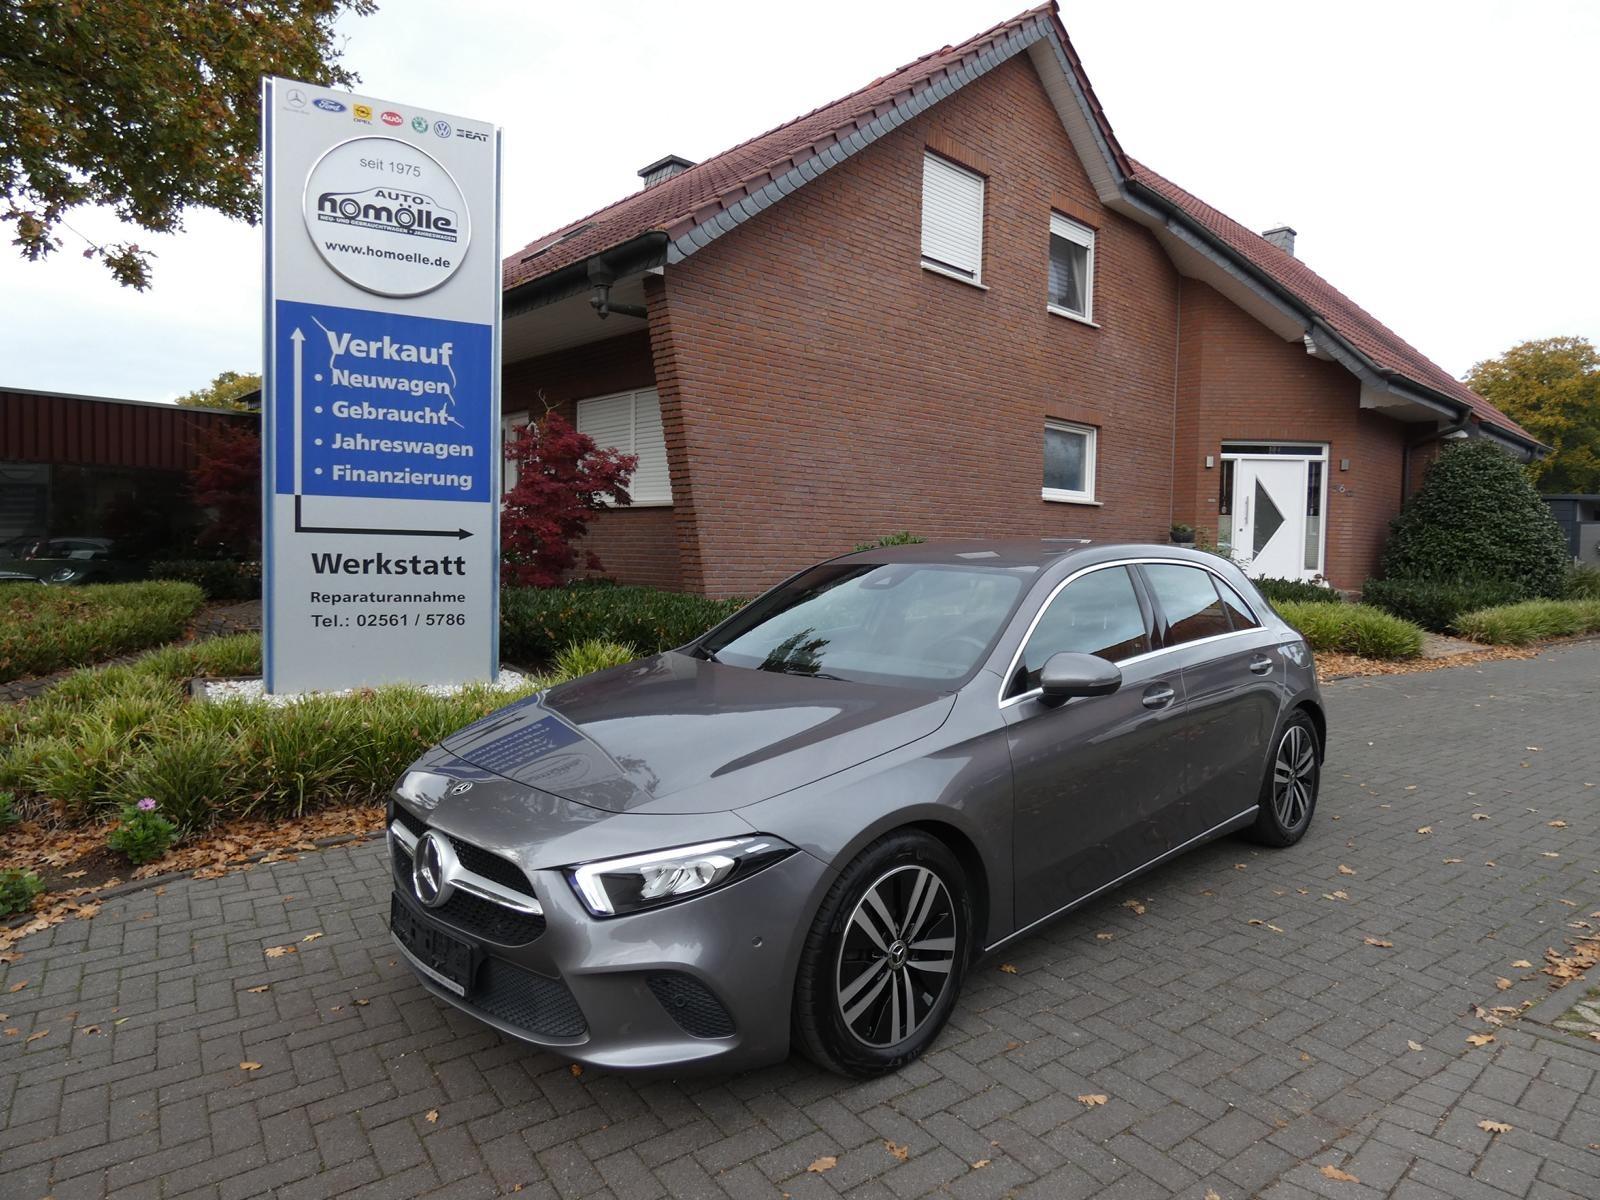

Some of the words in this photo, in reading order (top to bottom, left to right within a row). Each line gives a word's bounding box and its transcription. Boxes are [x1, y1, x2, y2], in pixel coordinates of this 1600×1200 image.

[360, 158, 383, 171] seit
[390, 161, 421, 178] 1975
[326, 241, 450, 268] www.homoelle.de
[327, 331, 453, 366] Verkauf
[332, 368, 450, 396] Neuwagen
[332, 433, 474, 459] Jahreswagen
[332, 465, 473, 491] Finanzierung
[311, 552, 466, 576] Werkstatt
[310, 591, 466, 606] Reparaturannahme
[311, 614, 350, 627] Tel.:
[356, 614, 408, 627] 02561
[425, 613, 466, 626] 5786
